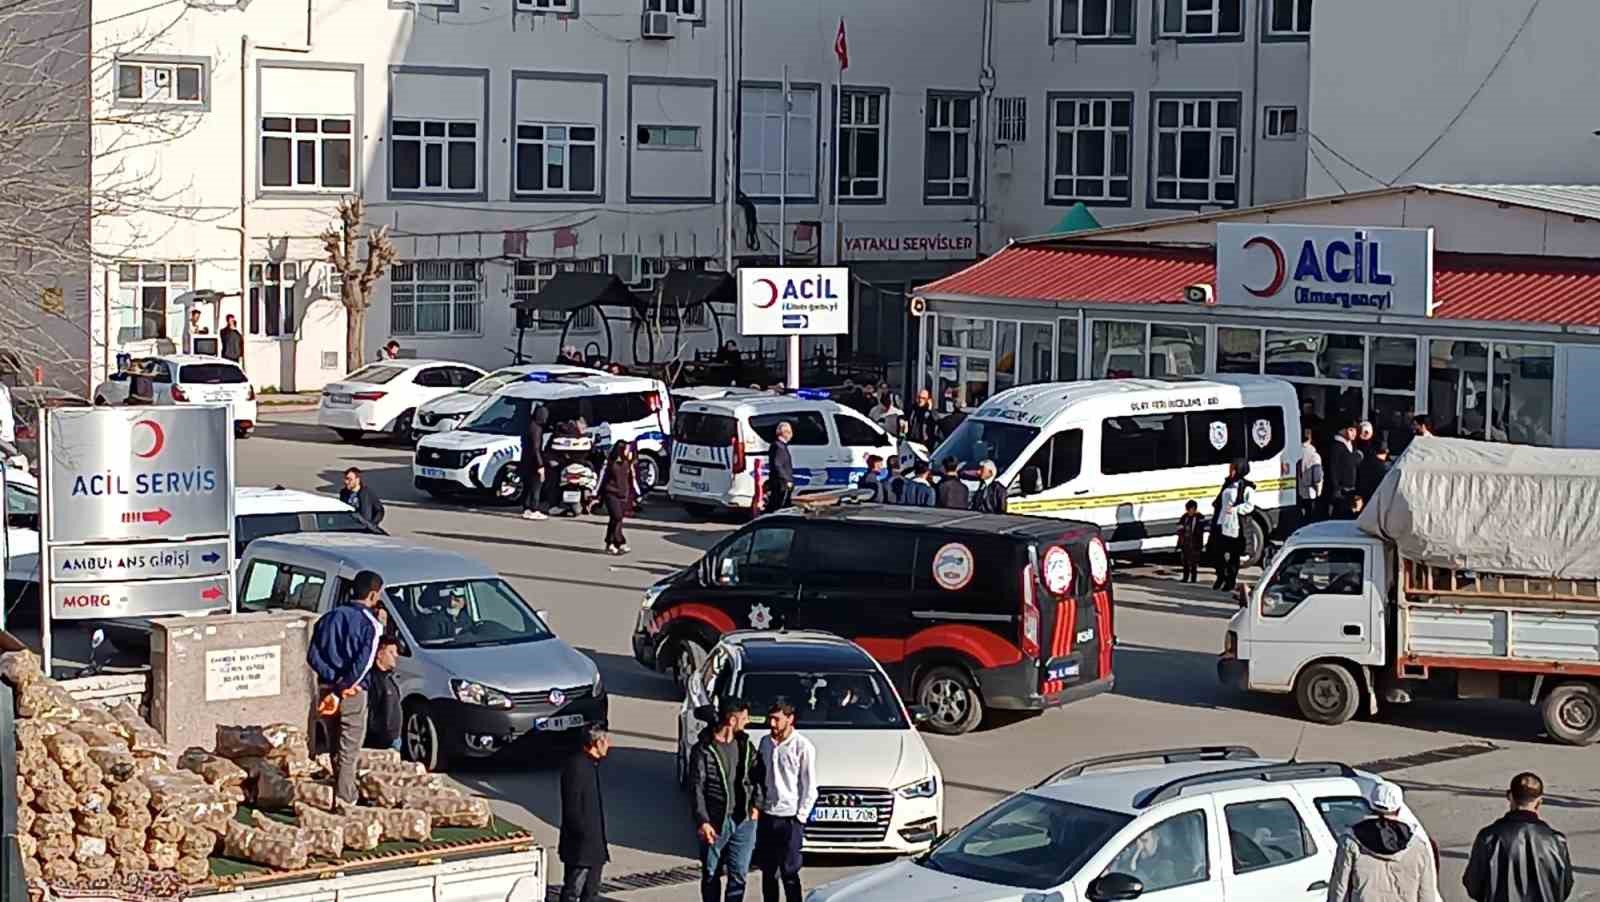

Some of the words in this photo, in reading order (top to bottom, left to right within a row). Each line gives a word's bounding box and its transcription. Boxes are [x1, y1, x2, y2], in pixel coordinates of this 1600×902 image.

[845, 237, 899, 251] YATAKLI
[903, 232, 973, 250] SERVİSLER
[1293, 231, 1393, 285] ACİL
[782, 274, 838, 299] ACİL
[72, 469, 129, 496] ACİL
[135, 465, 216, 494] SERVİS
[149, 551, 190, 569] GİRİŞİ
[63, 594, 111, 608] MORG
